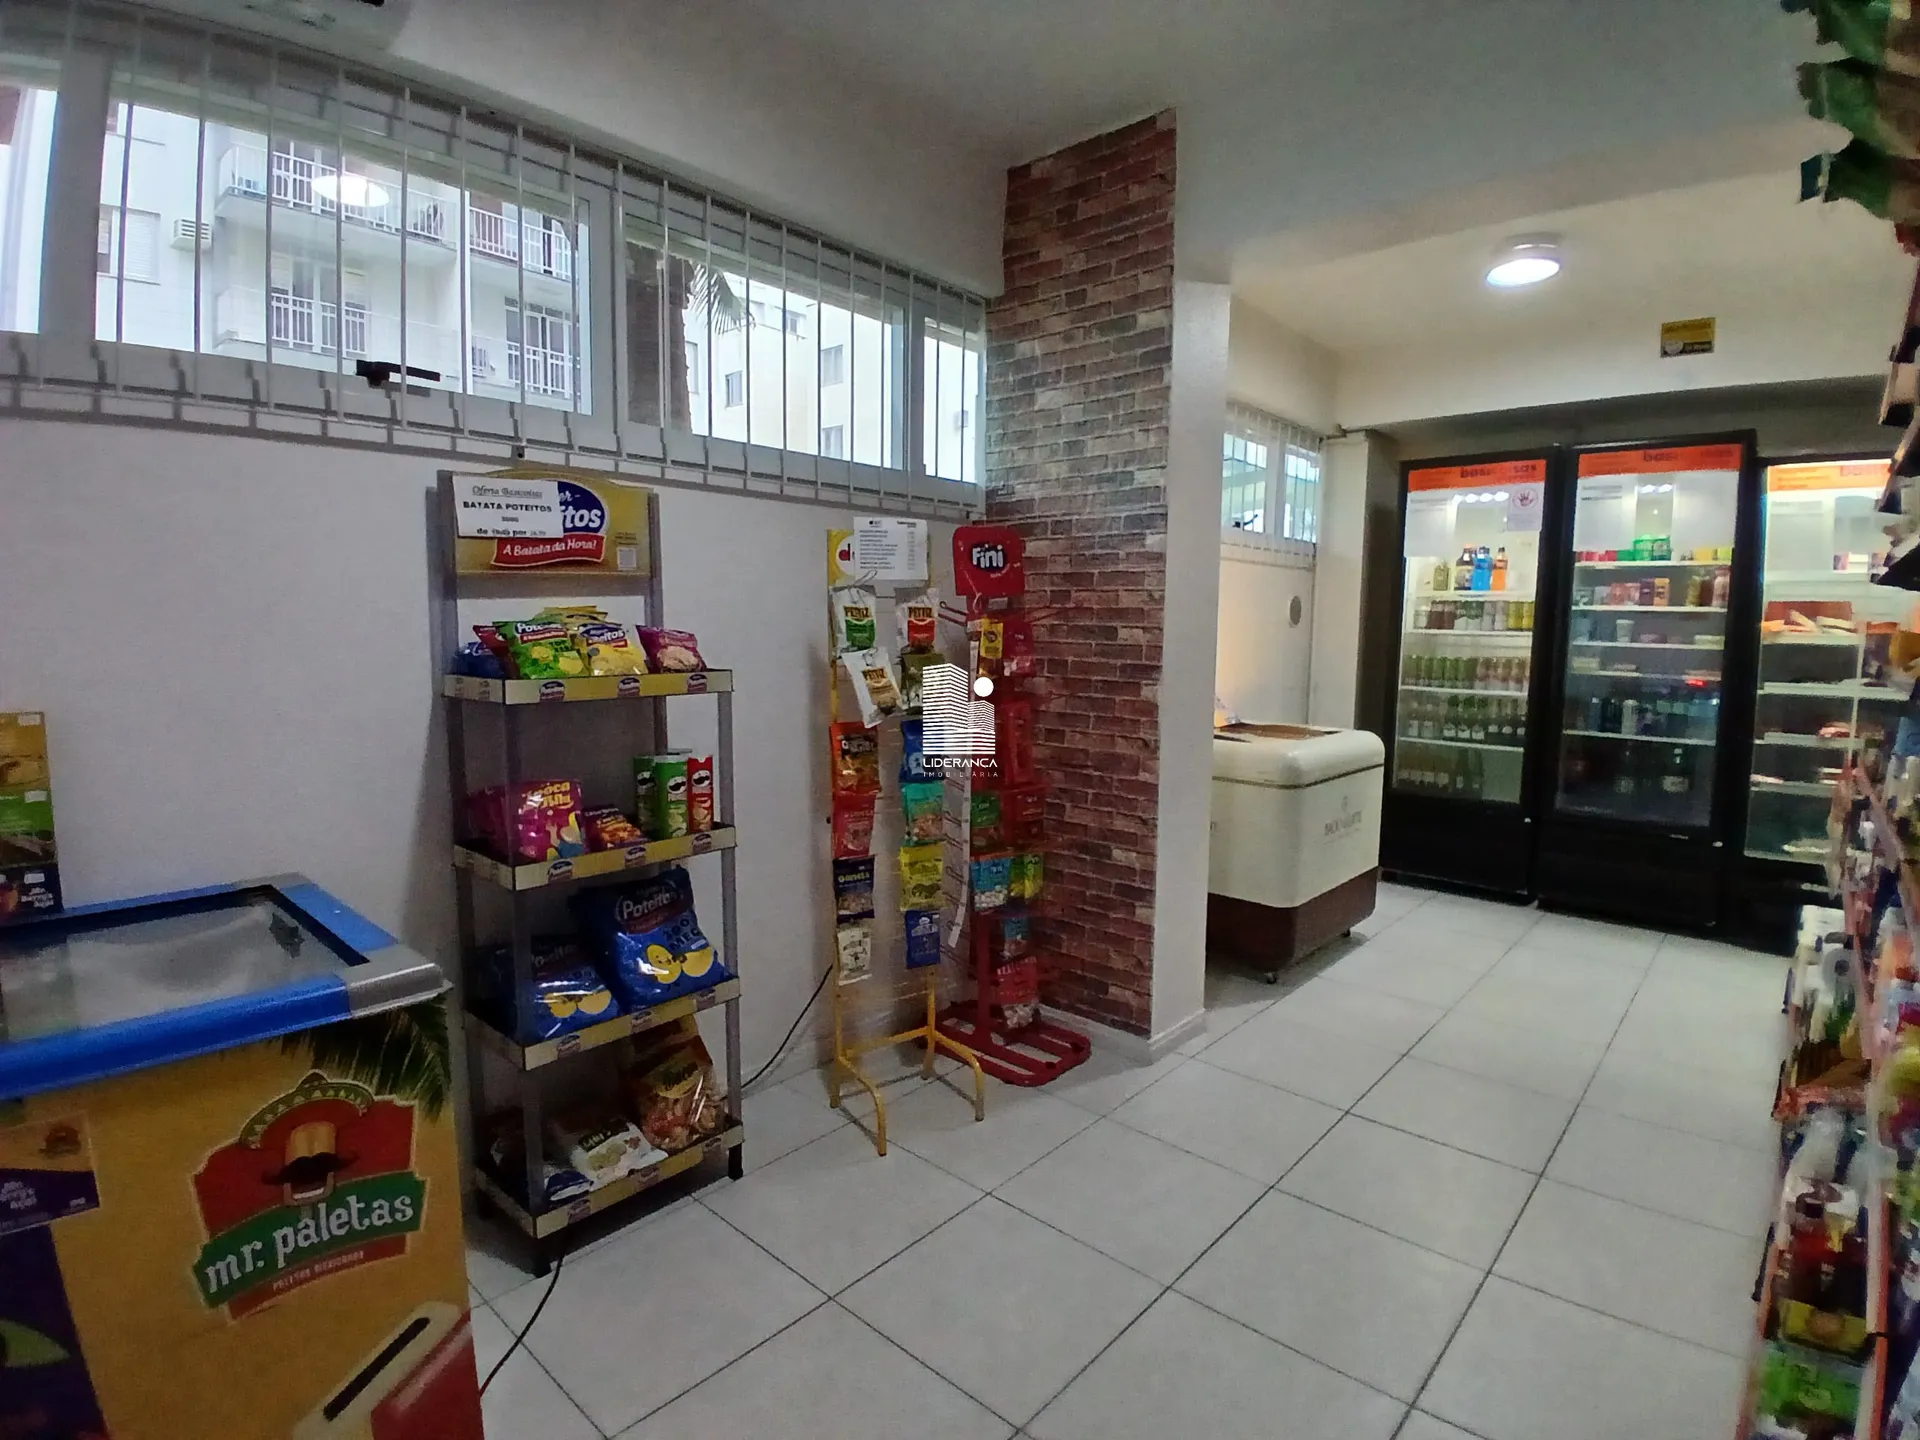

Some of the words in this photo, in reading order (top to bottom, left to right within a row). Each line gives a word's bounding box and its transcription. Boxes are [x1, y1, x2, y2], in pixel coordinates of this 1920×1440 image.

[463, 501, 503, 511] BATATA
[503, 544, 512, 555] A
[513, 544, 550, 556] Batata
[551, 542, 566, 552] da
[972, 543, 1004, 568] Fini
[204, 1240, 265, 1294] mr.
[272, 1194, 414, 1269] paletas
